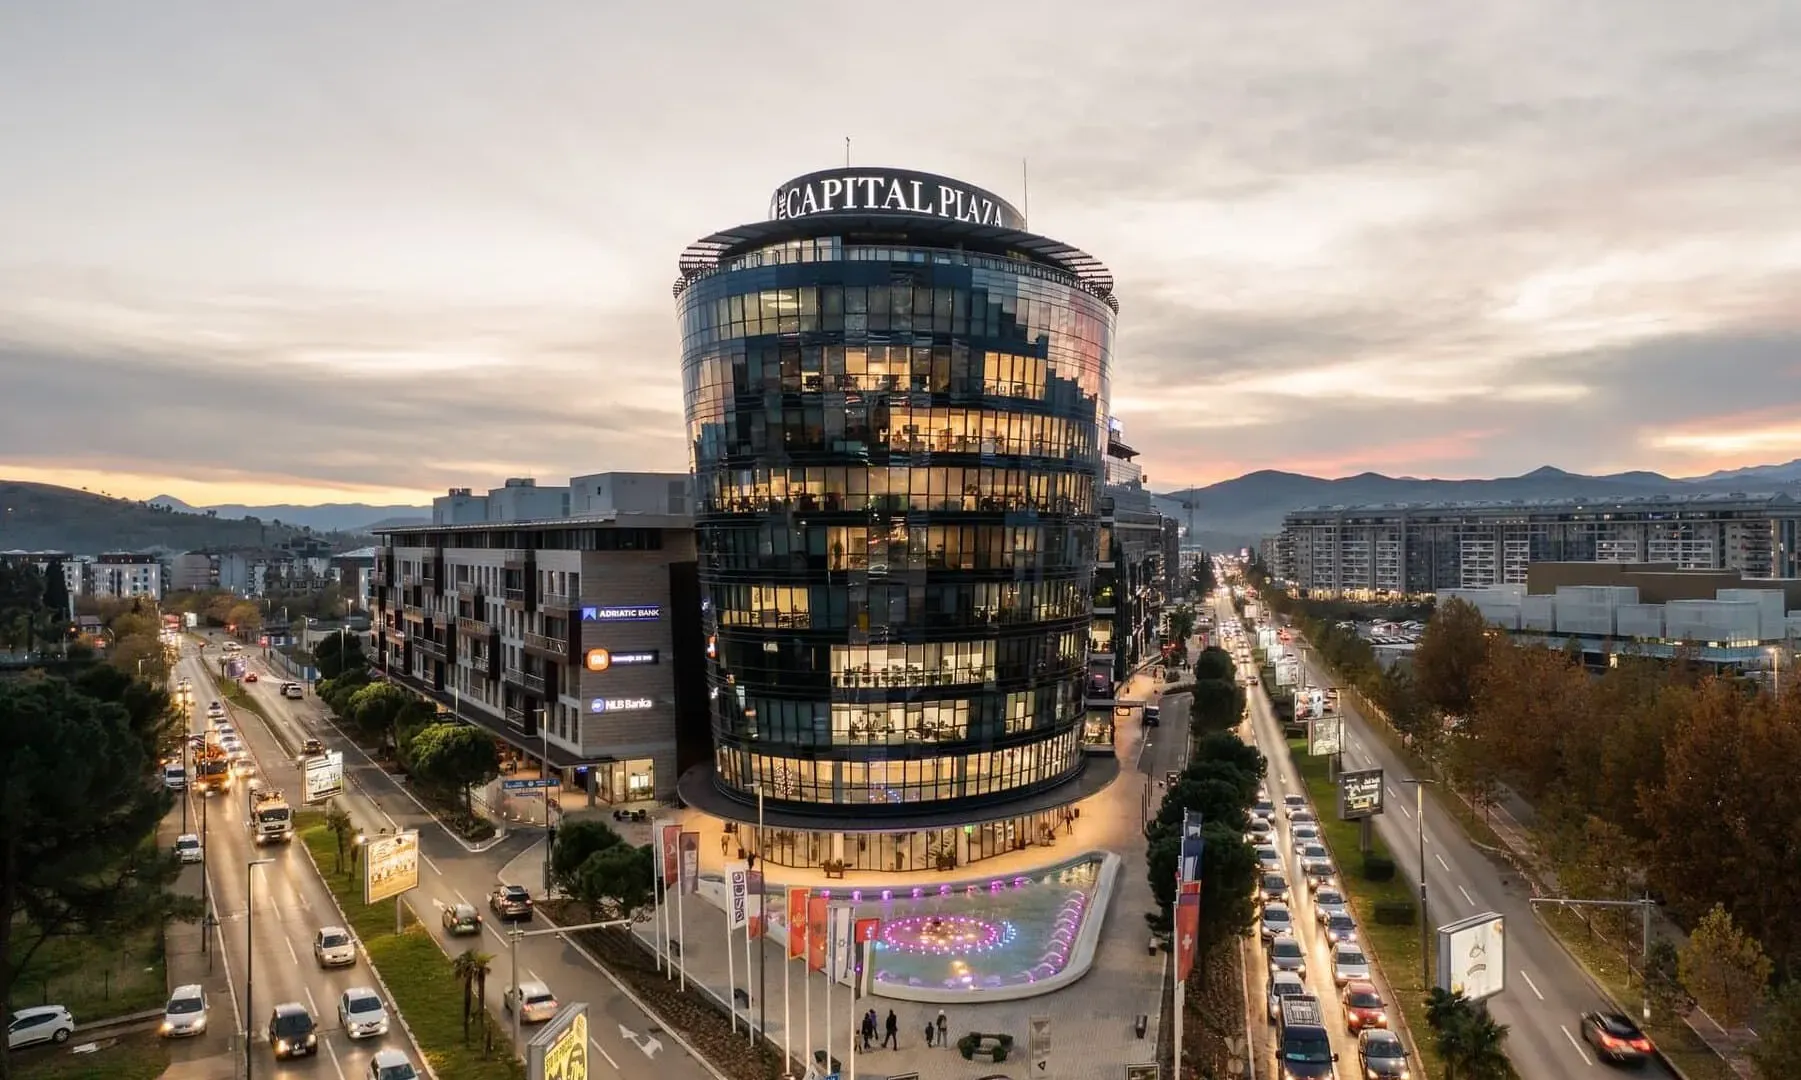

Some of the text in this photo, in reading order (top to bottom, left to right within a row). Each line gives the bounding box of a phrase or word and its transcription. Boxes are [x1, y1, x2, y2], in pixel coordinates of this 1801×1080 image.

[787, 177, 932, 218] CAPITAL
[938, 185, 1002, 227] PLAZA
[600, 609, 660, 618] ADRIATIC BANK
[605, 698, 652, 710] NLB Banka
